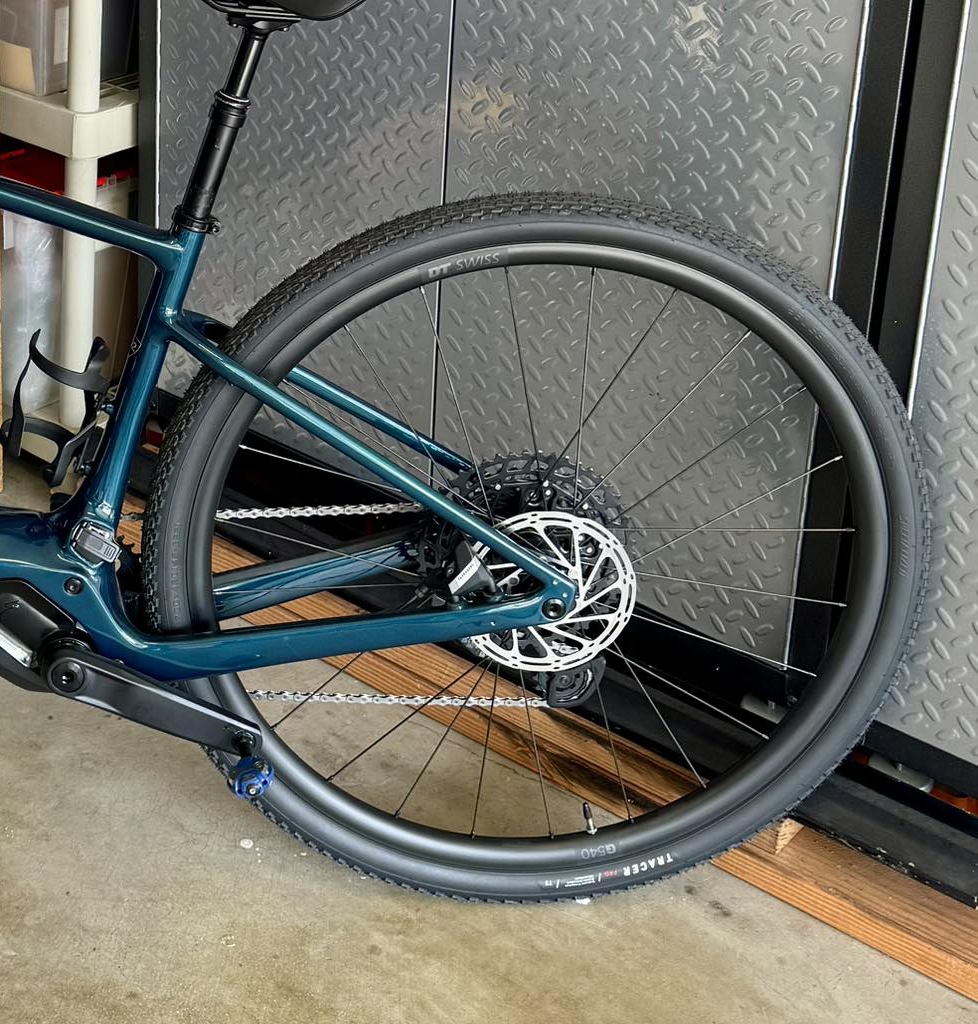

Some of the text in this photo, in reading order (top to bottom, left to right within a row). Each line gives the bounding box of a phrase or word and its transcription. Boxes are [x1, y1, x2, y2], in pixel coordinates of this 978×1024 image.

[428, 252, 500, 278] DT SWISS
[581, 843, 616, 859] G540
[623, 853, 674, 876] TRACER
